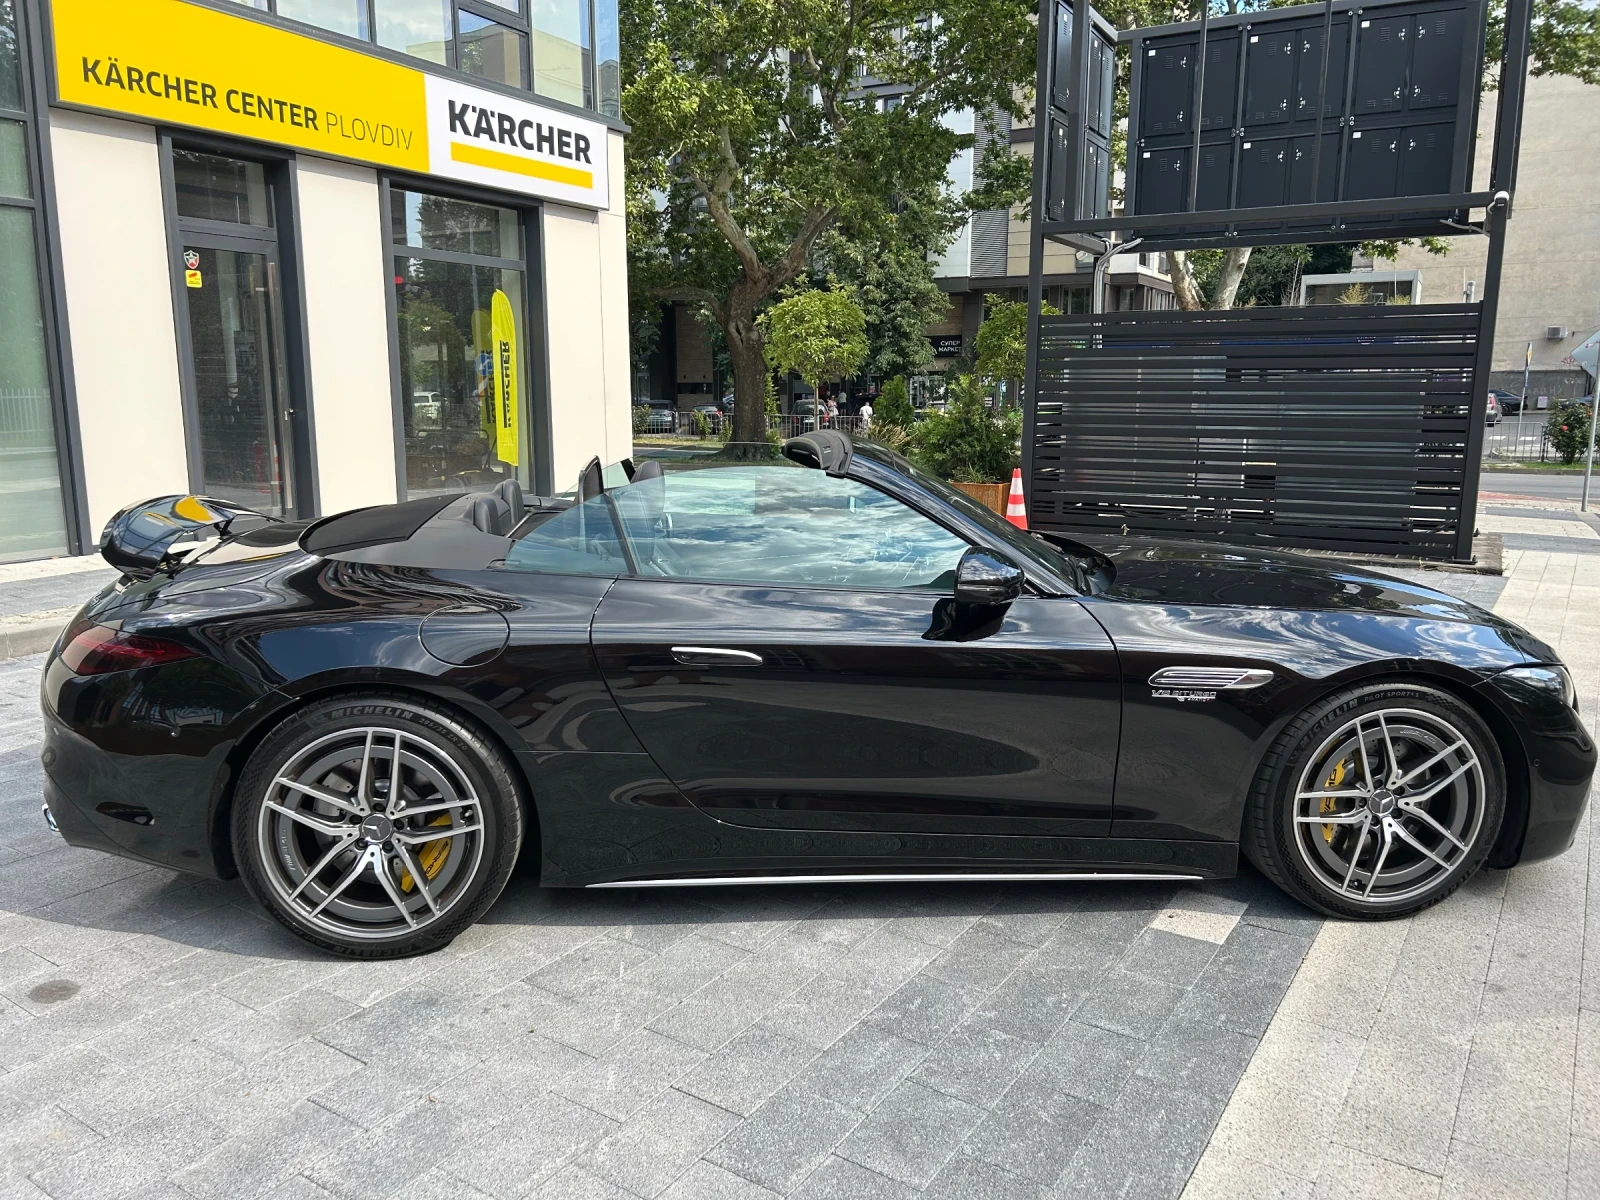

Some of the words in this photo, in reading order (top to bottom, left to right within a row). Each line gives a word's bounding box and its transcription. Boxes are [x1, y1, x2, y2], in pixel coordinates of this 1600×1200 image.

[82, 56, 218, 109] KÄRCHER
[226, 89, 319, 131] CENTER
[326, 111, 413, 151] PLOVDIV
[448, 99, 592, 164] KÄRCHER
[332, 705, 414, 720] MICHELIN
[1300, 698, 1358, 748] MICHELIN
[1364, 692, 1385, 702] PILOT
[333, 945, 412, 957] MICHELIN
